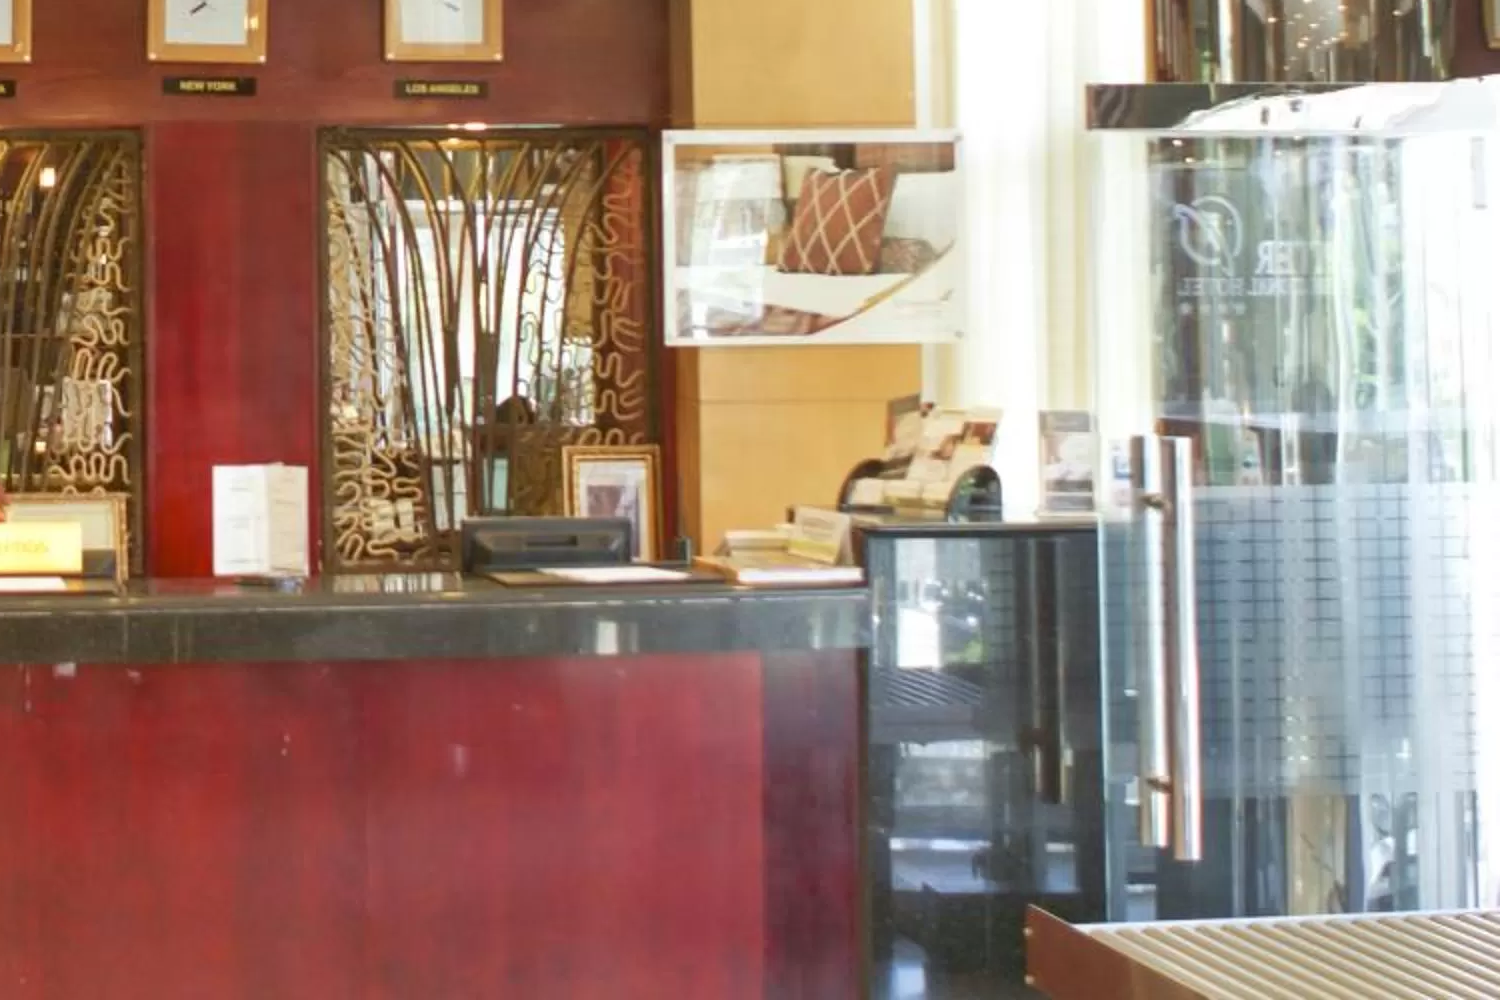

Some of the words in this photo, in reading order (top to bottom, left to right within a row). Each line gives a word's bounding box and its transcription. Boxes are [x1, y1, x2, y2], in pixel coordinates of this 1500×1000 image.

[178, 80, 204, 91] NEW
[205, 80, 237, 92] YORK
[405, 83, 426, 94] LOS
